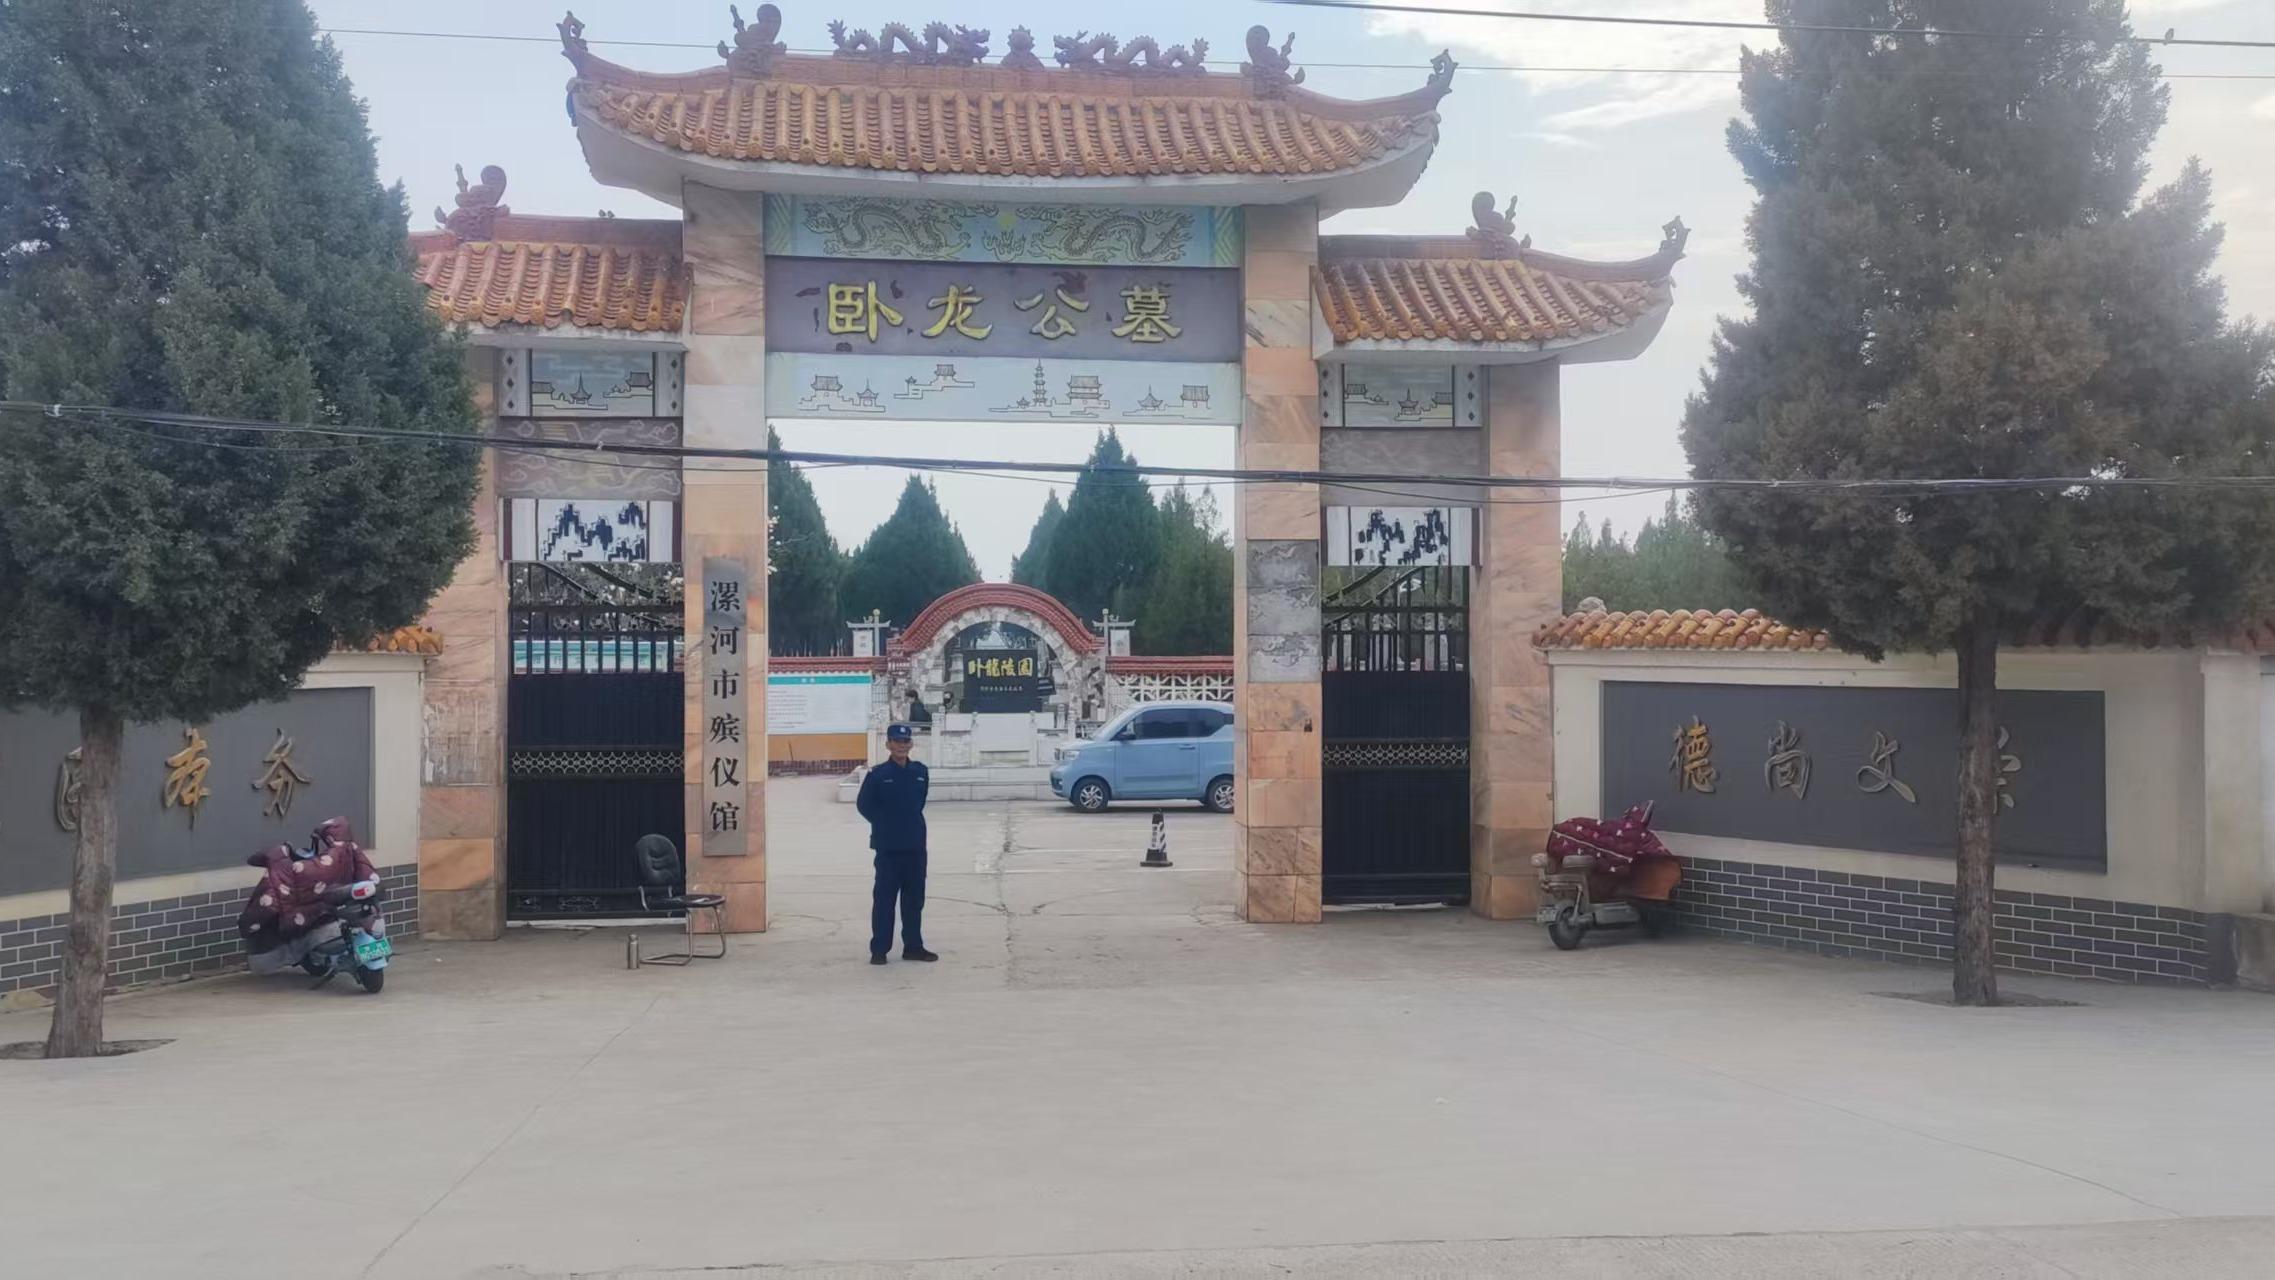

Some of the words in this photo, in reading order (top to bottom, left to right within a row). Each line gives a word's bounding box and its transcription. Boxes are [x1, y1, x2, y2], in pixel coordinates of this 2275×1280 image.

[827, 280, 1182, 343] 卧龙公墓
[710, 580, 741, 832] 漯河市殡仪馆
